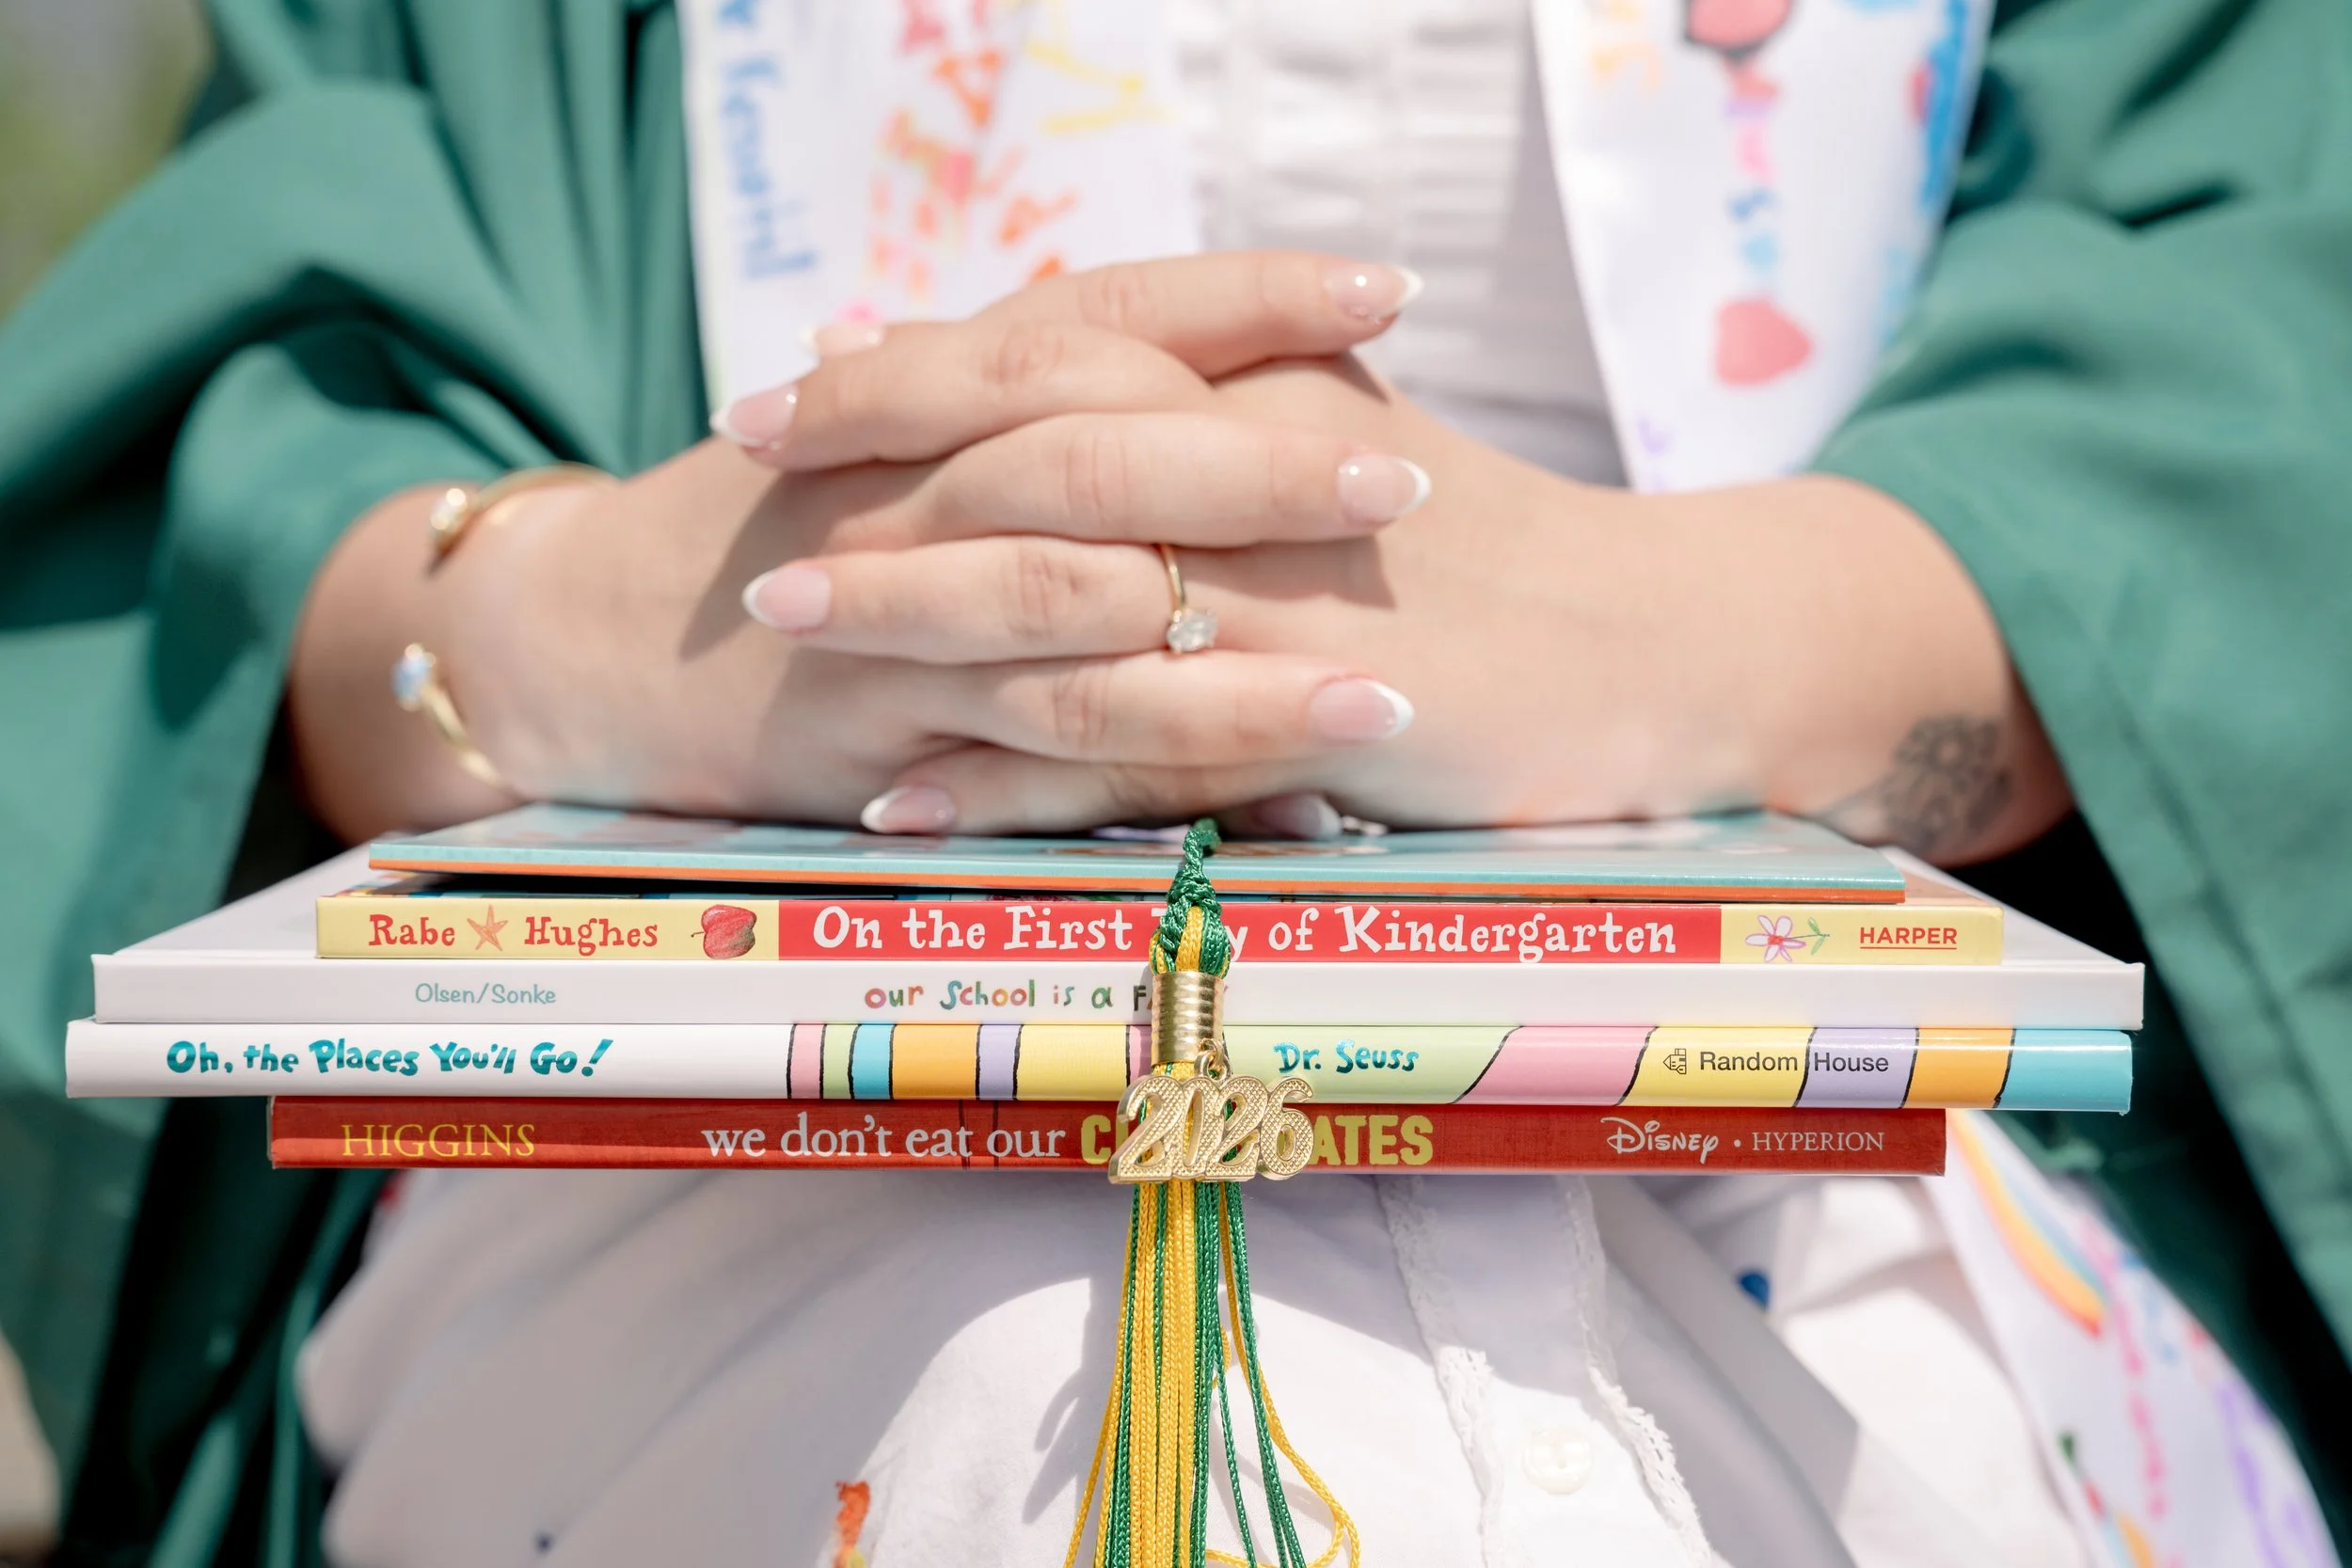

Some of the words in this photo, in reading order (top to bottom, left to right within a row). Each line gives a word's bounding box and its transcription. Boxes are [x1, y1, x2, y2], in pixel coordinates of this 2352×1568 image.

[369, 914, 454, 946] Rabe
[524, 916, 658, 957] Hughes
[814, 906, 882, 948] On
[902, 908, 985, 949] the
[1004, 906, 1132, 950] First
[1268, 908, 1319, 951] of
[1334, 906, 1676, 963] Kindergarten
[1860, 927, 1957, 944] HARPER
[416, 983, 556, 1005] Olsen/Sonke
[865, 986, 923, 1008] our
[940, 979, 1035, 1010] School
[1054, 985, 1073, 1006] is
[1091, 987, 1113, 1008] a
[167, 1041, 232, 1073] Oh,
[244, 1044, 299, 1072] the
[309, 1038, 419, 1076] Places
[429, 1042, 516, 1074] You'll
[531, 1039, 613, 1077] Go!
[1275, 1042, 1321, 1072] Dr.
[1336, 1039, 1419, 1073] Seuss
[1701, 1052, 1797, 1070] Random
[1815, 1053, 1888, 1071] House
[341, 1124, 535, 1157] HIGGINS
[701, 1129, 766, 1157] we
[781, 1112, 892, 1157] don't
[905, 1125, 974, 1157] eat
[987, 1128, 1066, 1157] our
[1108, 1075, 1314, 1183] 2026
[1752, 1132, 1883, 1151] HYPERION
